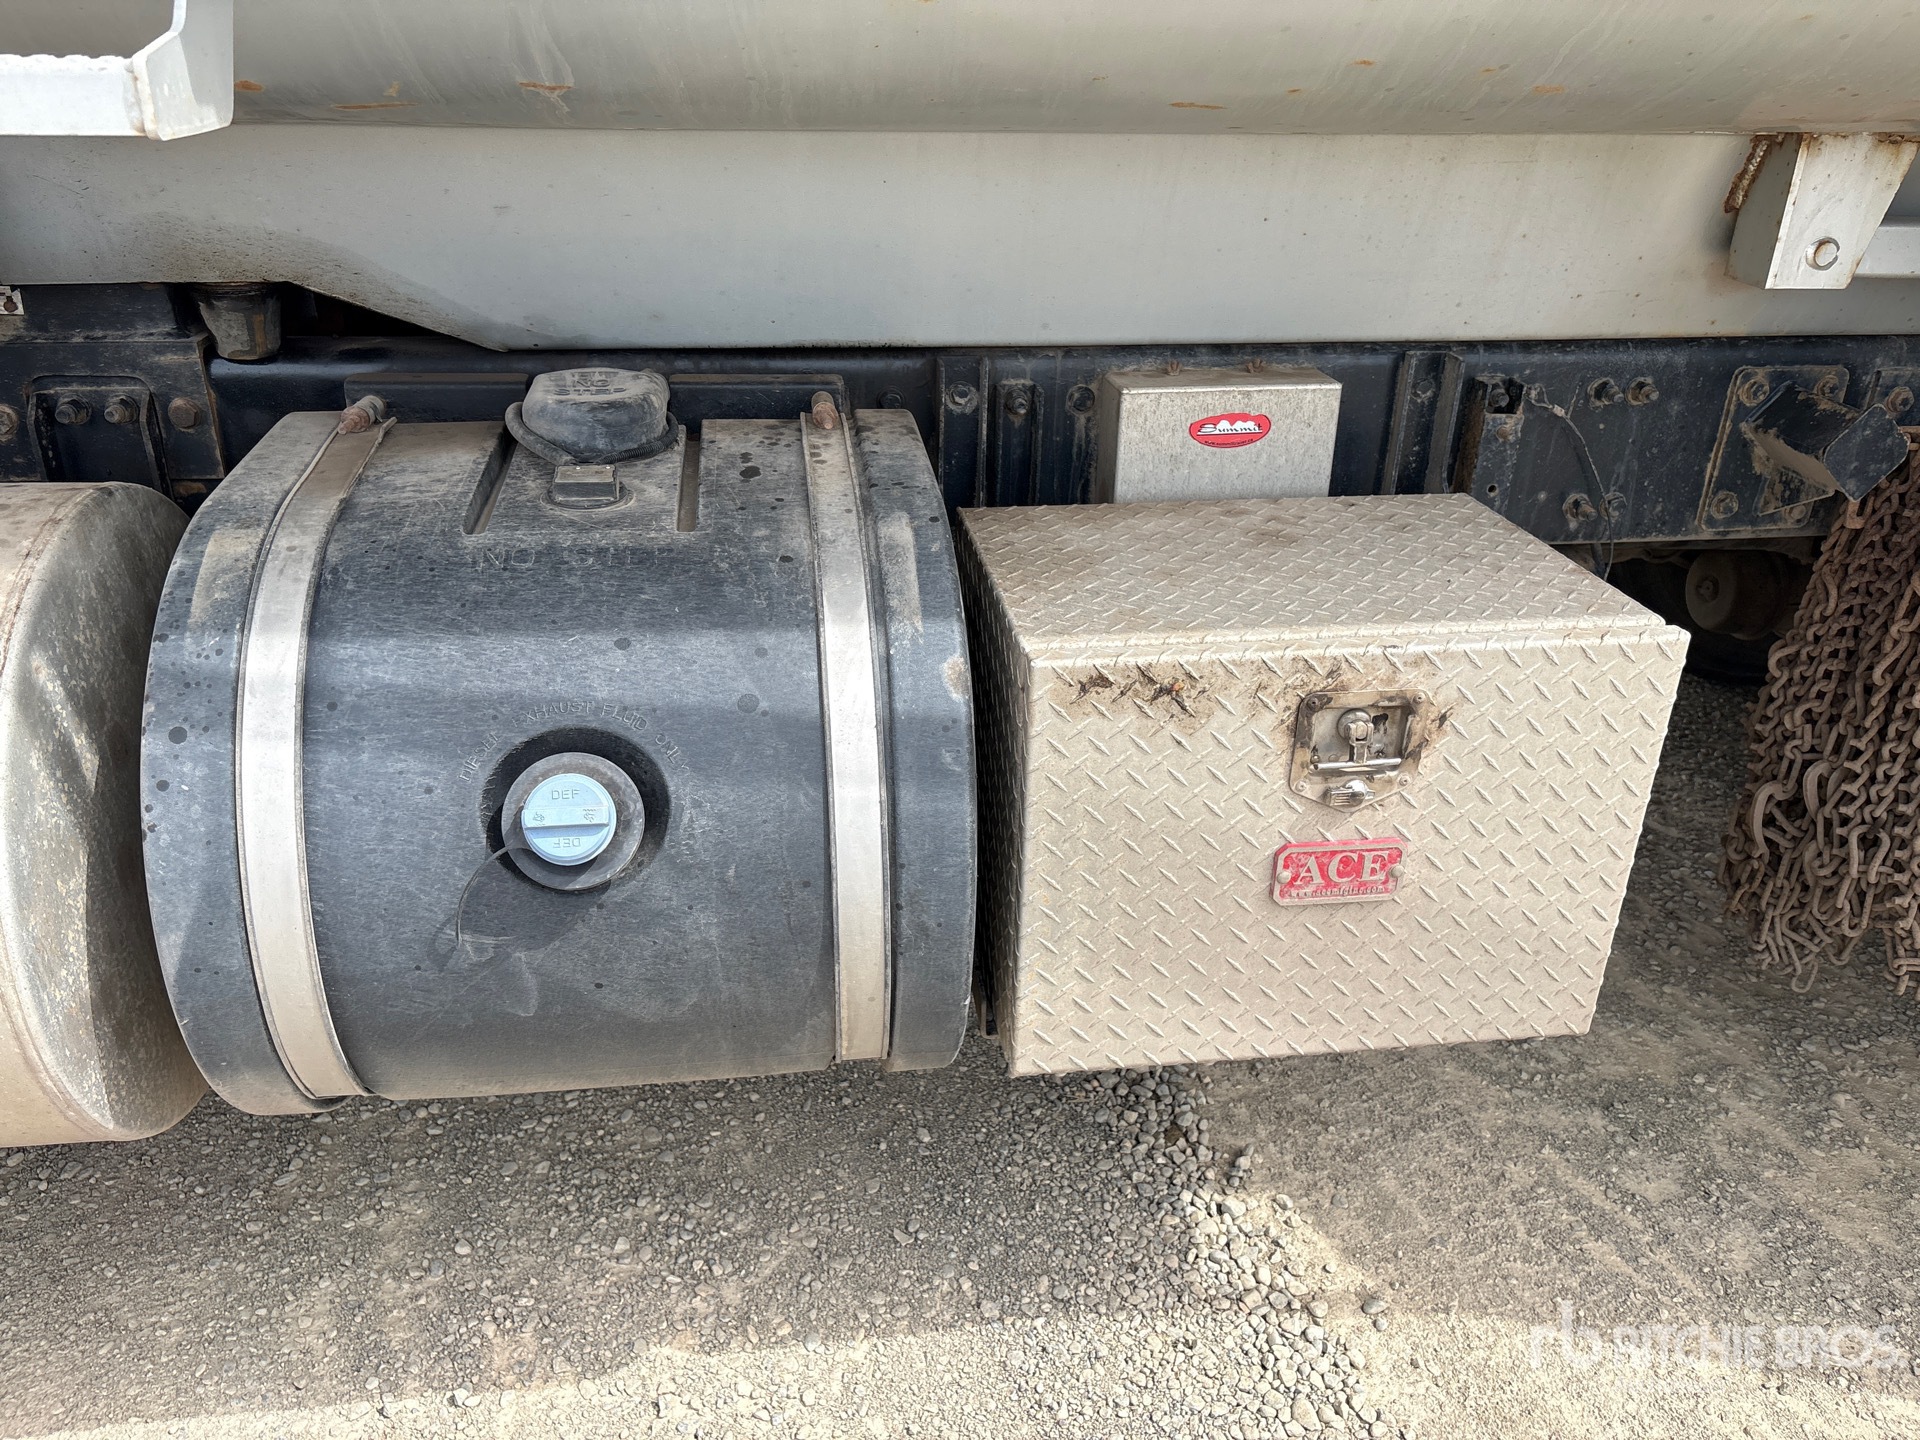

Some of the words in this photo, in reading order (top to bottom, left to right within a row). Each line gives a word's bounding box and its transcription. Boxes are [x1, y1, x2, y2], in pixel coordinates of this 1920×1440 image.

[1197, 422, 1264, 434] Summit
[601, 702, 649, 731] FLUID
[551, 788, 580, 800] DEF
[552, 837, 581, 849] DEF
[1293, 851, 1390, 885] ACE
